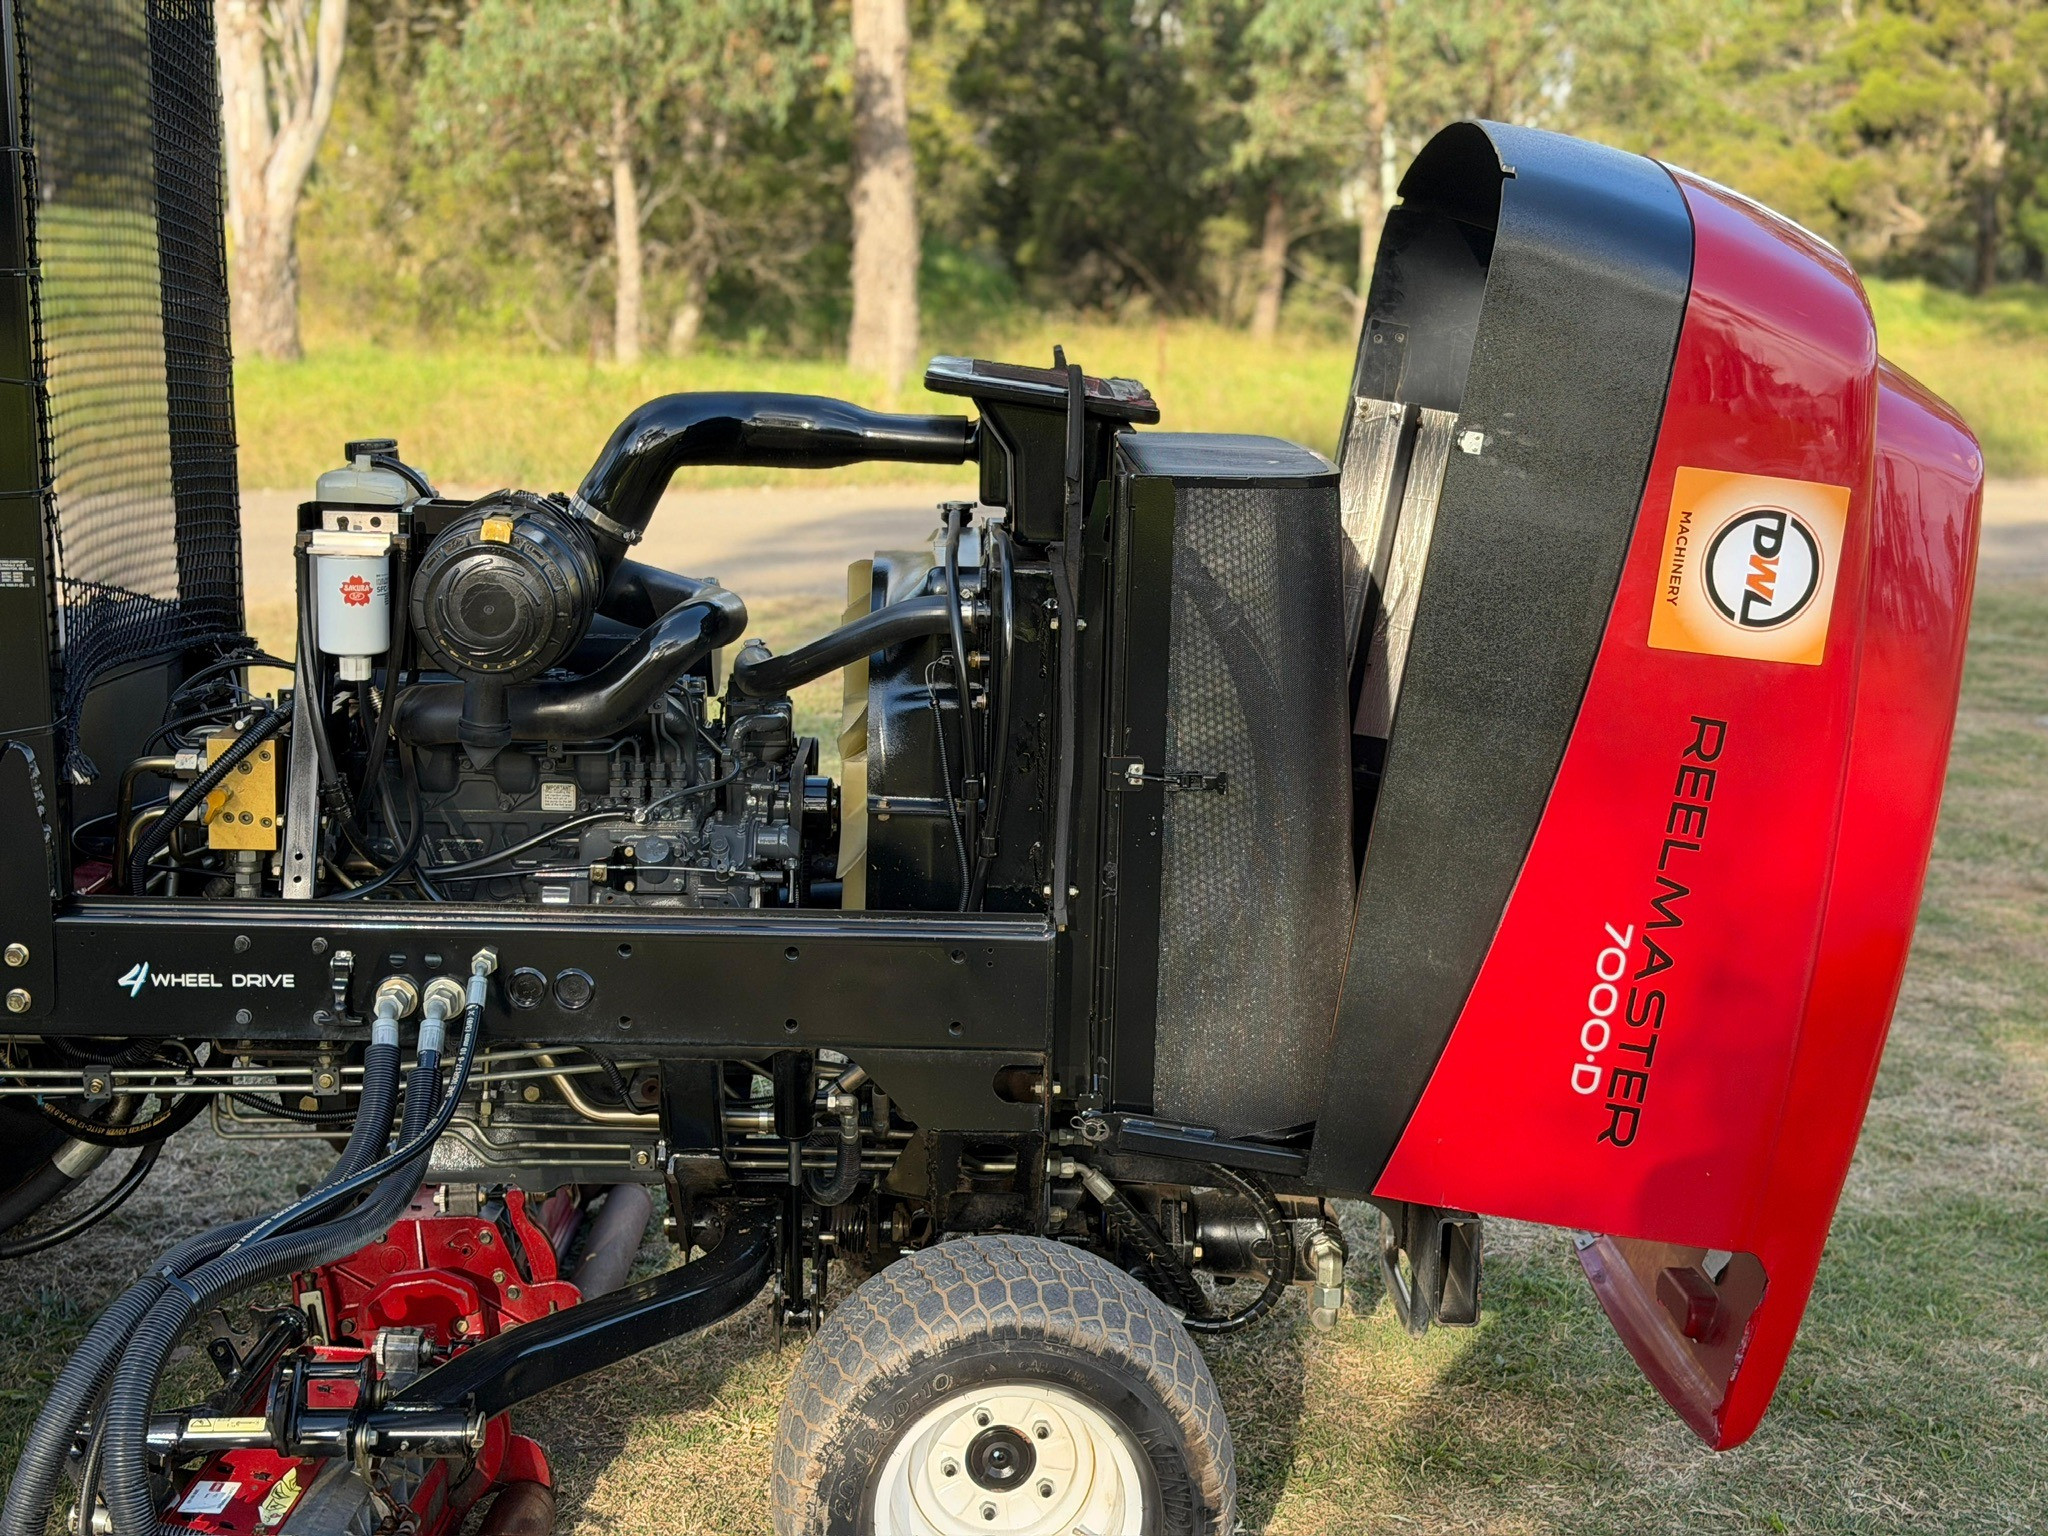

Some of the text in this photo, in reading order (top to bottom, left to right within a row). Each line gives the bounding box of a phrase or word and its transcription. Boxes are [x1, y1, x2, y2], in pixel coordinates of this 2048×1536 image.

[1666, 511, 1694, 607] MACHINERY
[1739, 511, 1788, 627] DWL
[117, 961, 295, 998] 4 WHEEL DRIVE
[1596, 715, 1729, 1149] REELMASTER
